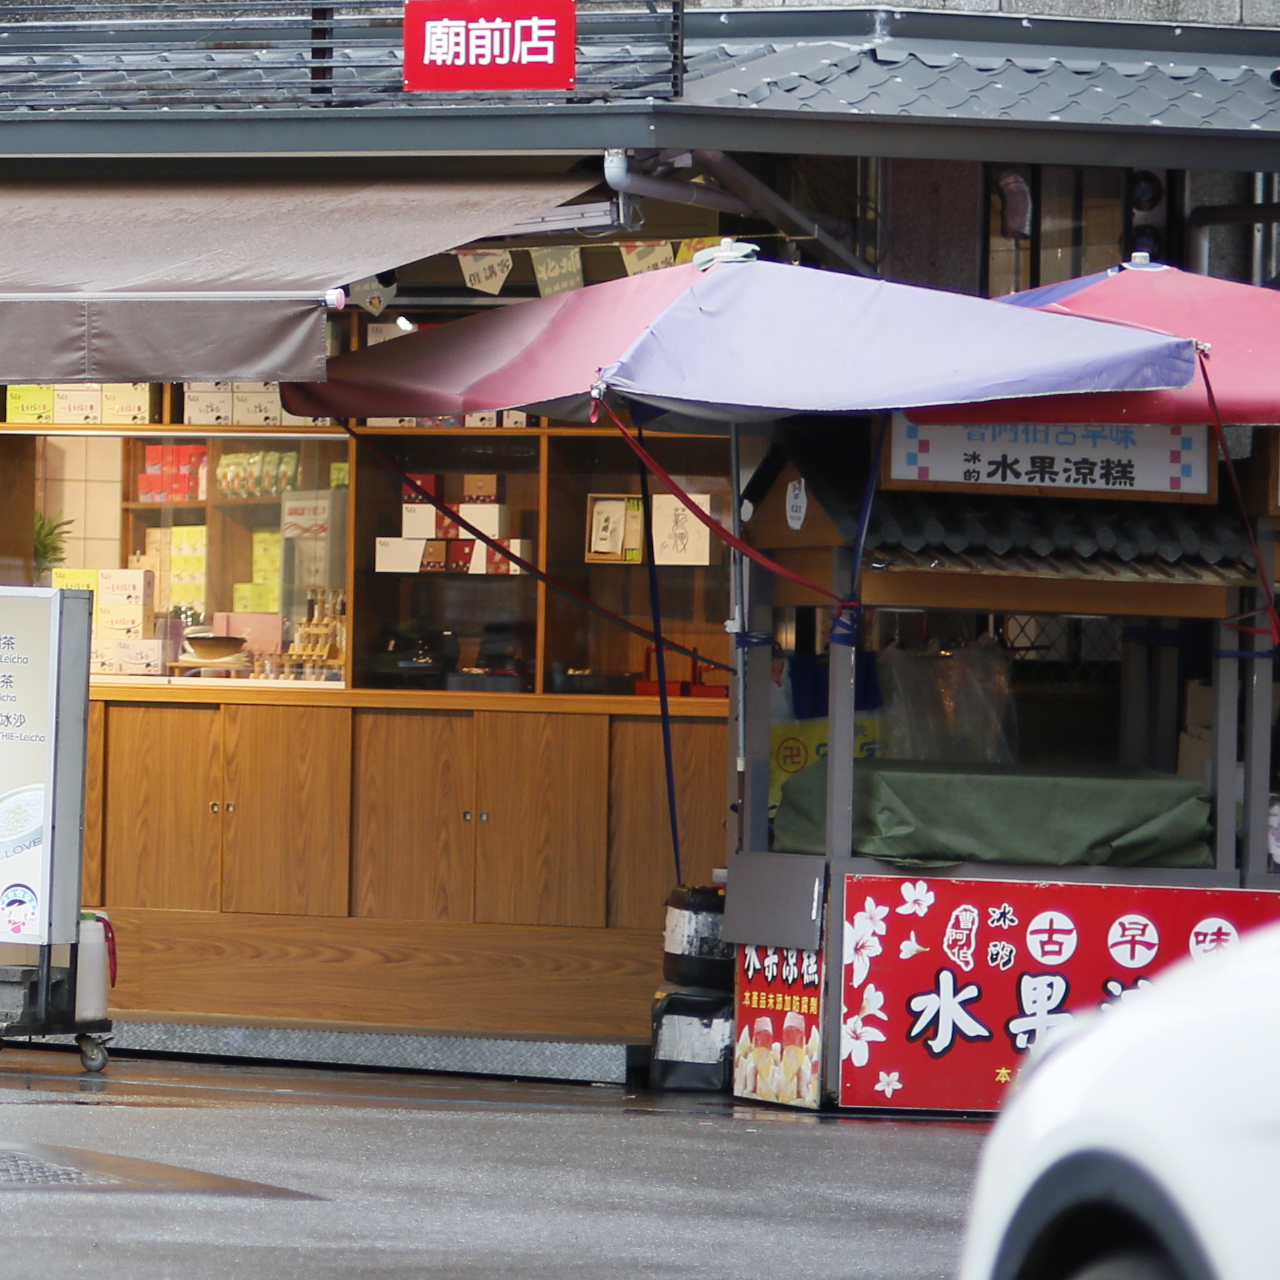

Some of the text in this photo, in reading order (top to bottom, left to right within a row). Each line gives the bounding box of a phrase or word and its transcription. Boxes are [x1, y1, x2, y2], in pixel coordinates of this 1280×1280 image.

[423, 16, 556, 65] 廟前店
[963, 451, 981, 482] 冰的
[986, 453, 1136, 487] 水果涼糕
[4, 836, 43, 858] LOVE
[948, 908, 974, 961] 曹阿伯
